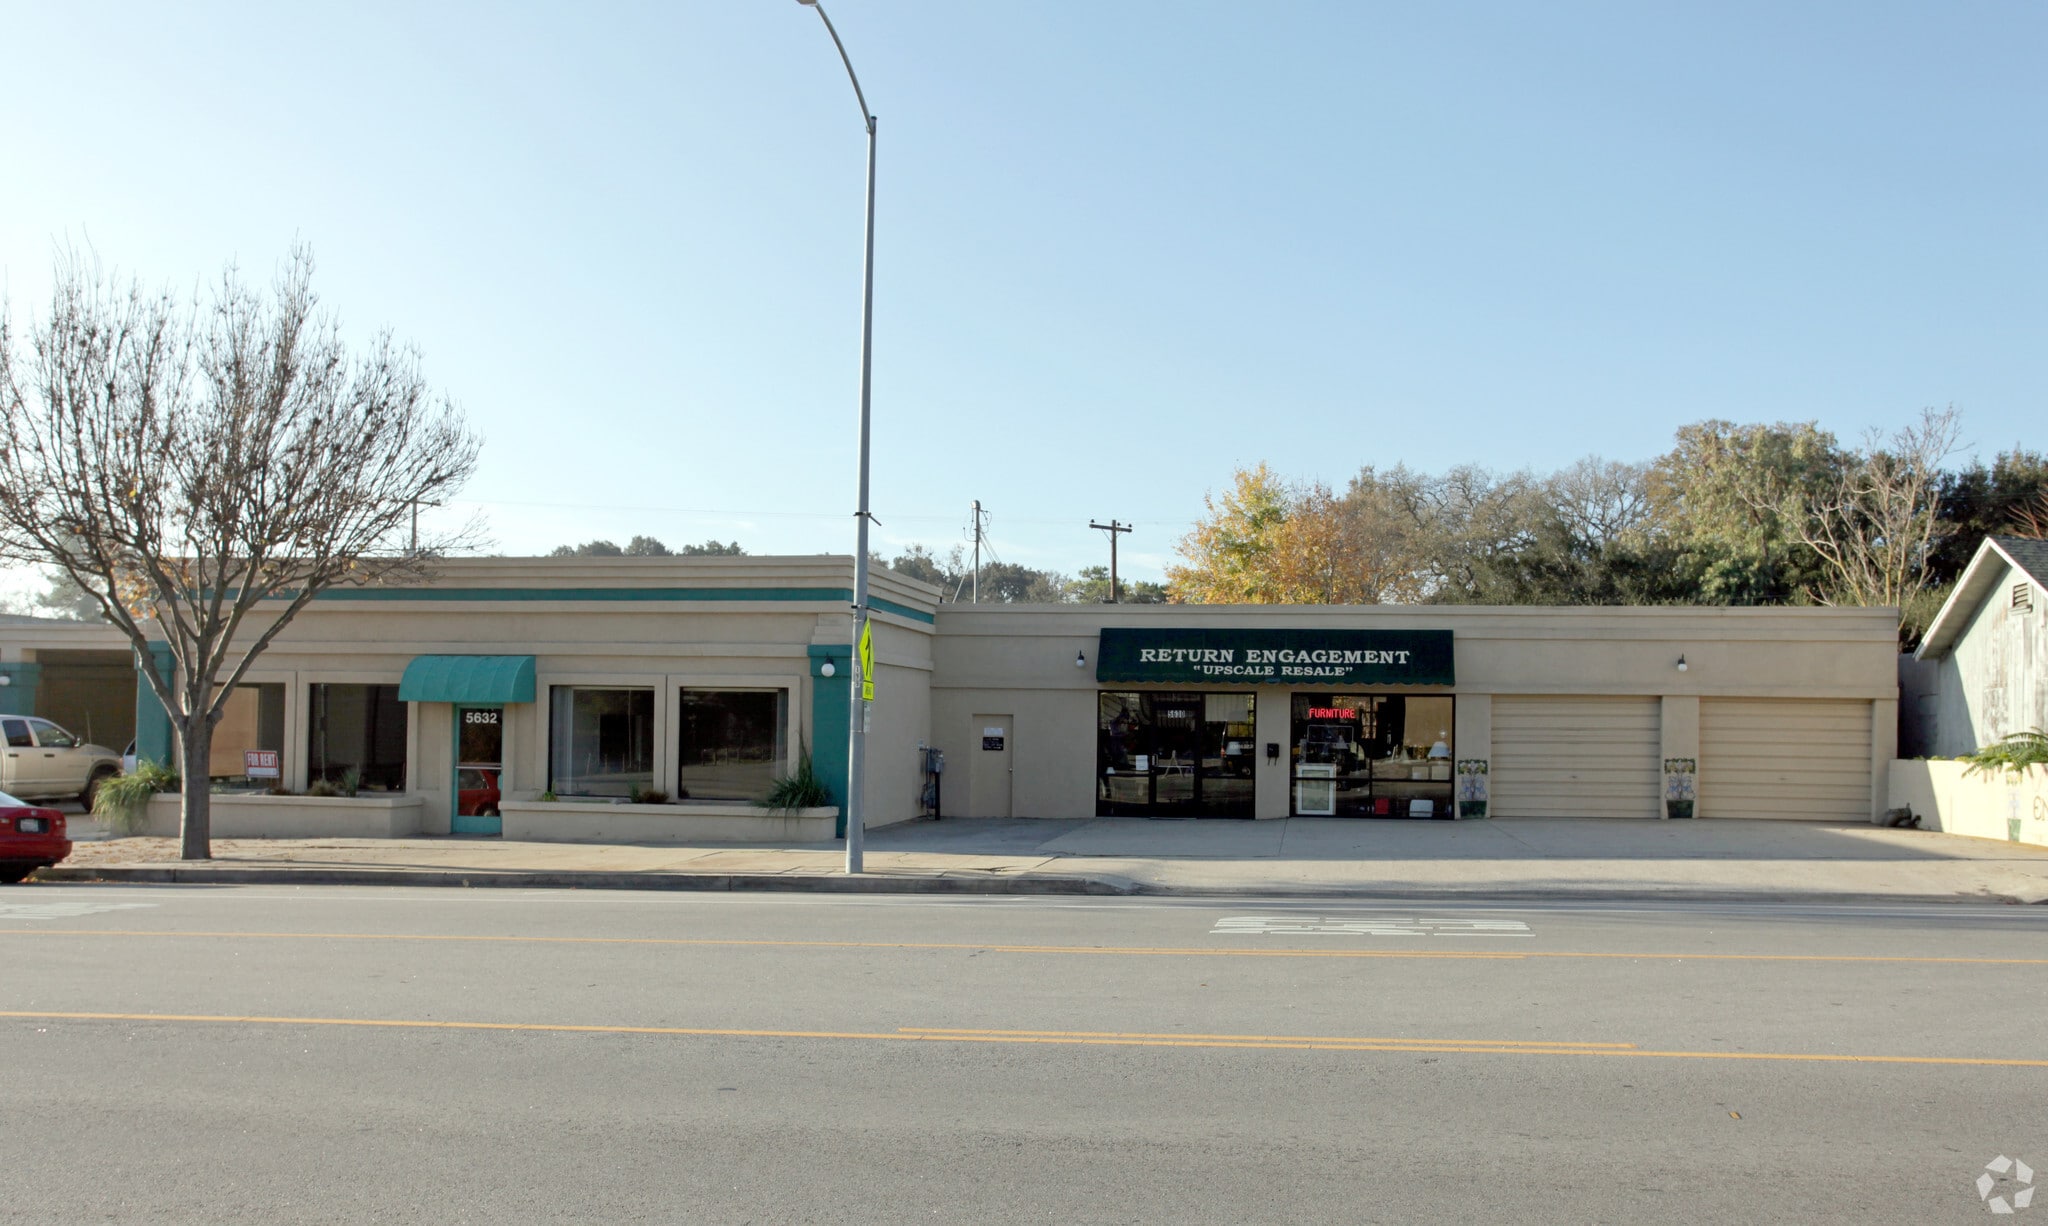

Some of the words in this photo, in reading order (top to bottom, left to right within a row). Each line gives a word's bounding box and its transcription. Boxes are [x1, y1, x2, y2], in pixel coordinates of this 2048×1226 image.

[1139, 648, 1234, 663] RETURN
[1246, 649, 1411, 664] ENGAGEMENT
[465, 712, 498, 724] 5632
[1308, 707, 1356, 719] FURNITURE
[247, 753, 259, 766] FOR
